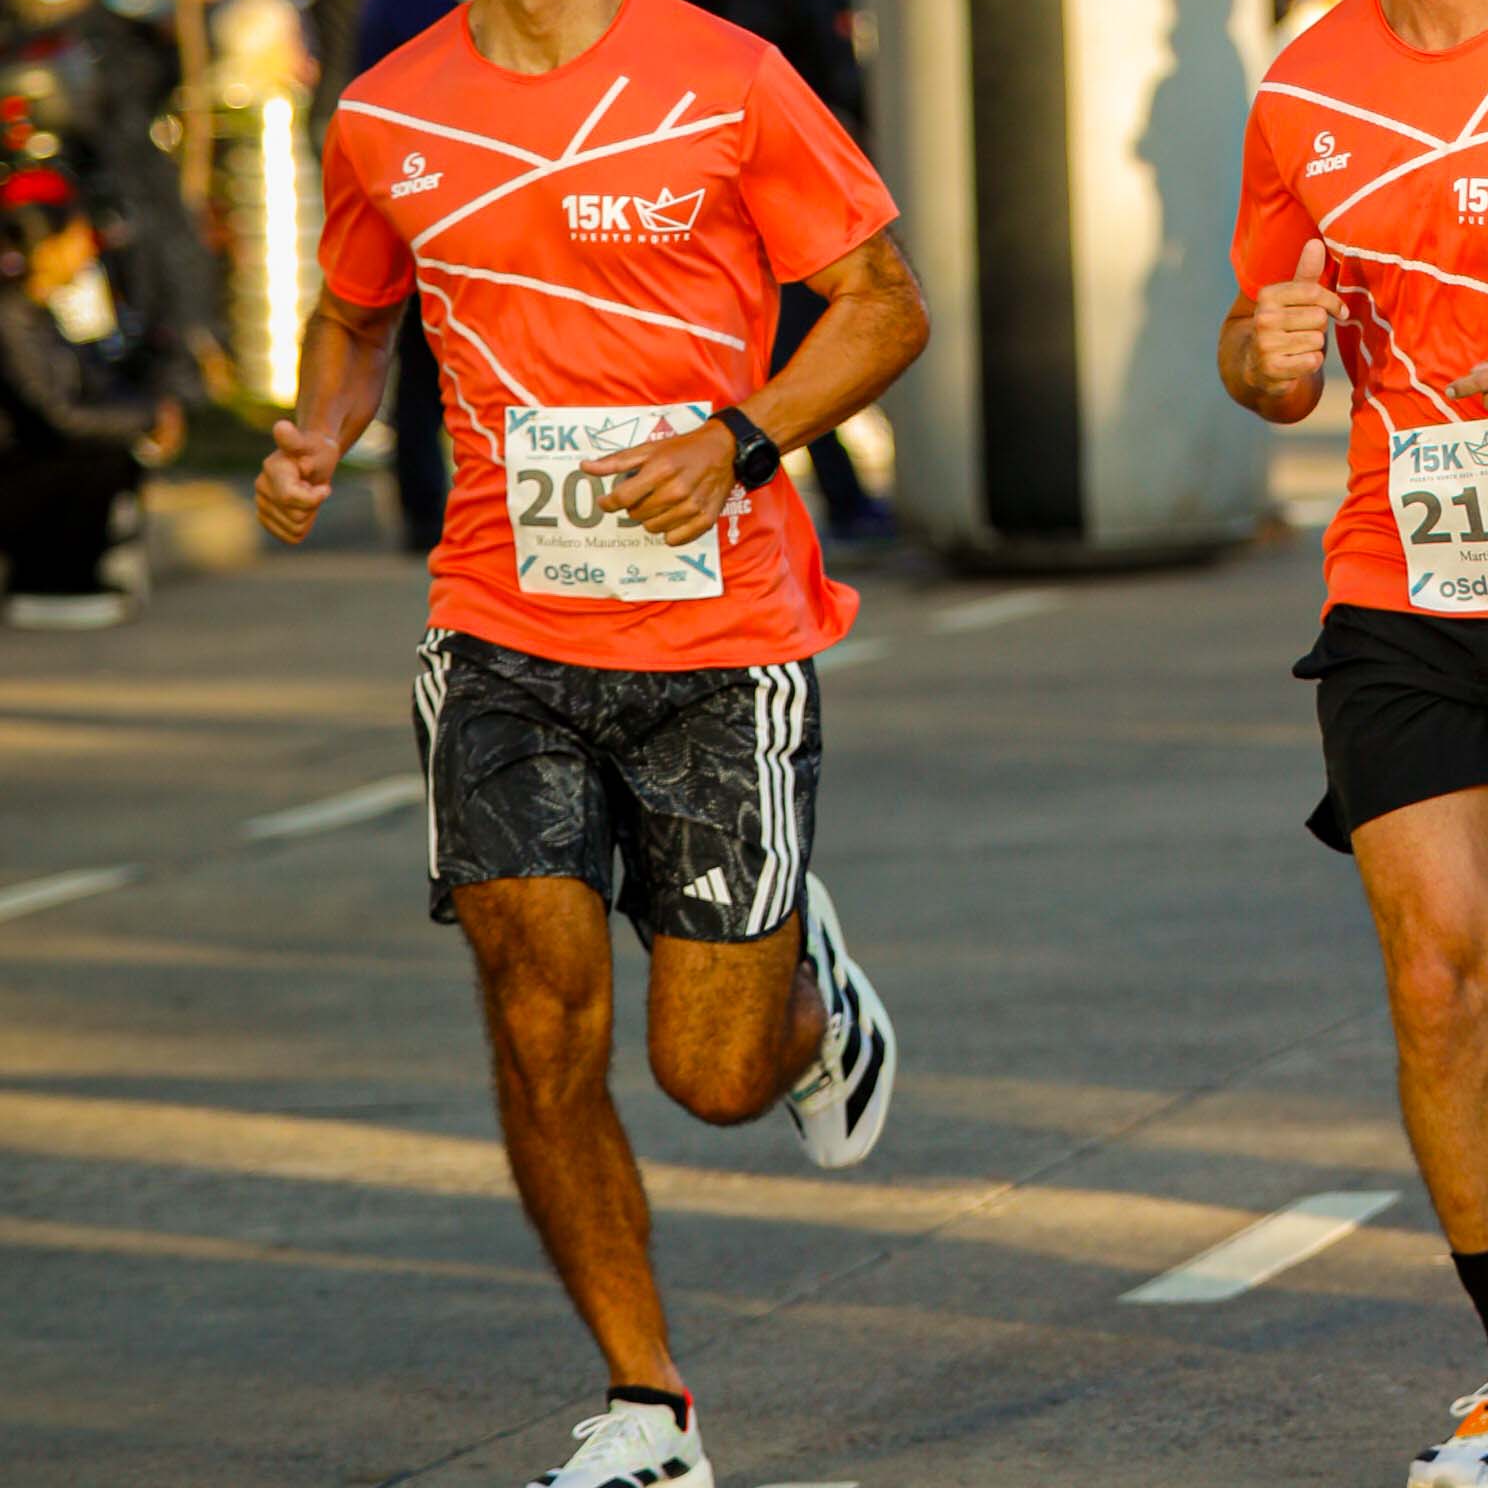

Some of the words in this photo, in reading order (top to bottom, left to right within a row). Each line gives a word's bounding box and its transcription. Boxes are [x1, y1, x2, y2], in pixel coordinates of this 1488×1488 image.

[562, 194, 632, 230] 15K
[570, 232, 631, 243] PUERTO
[527, 425, 580, 451] 15K
[1410, 442, 1464, 473] 15K
[544, 563, 605, 585] osde
